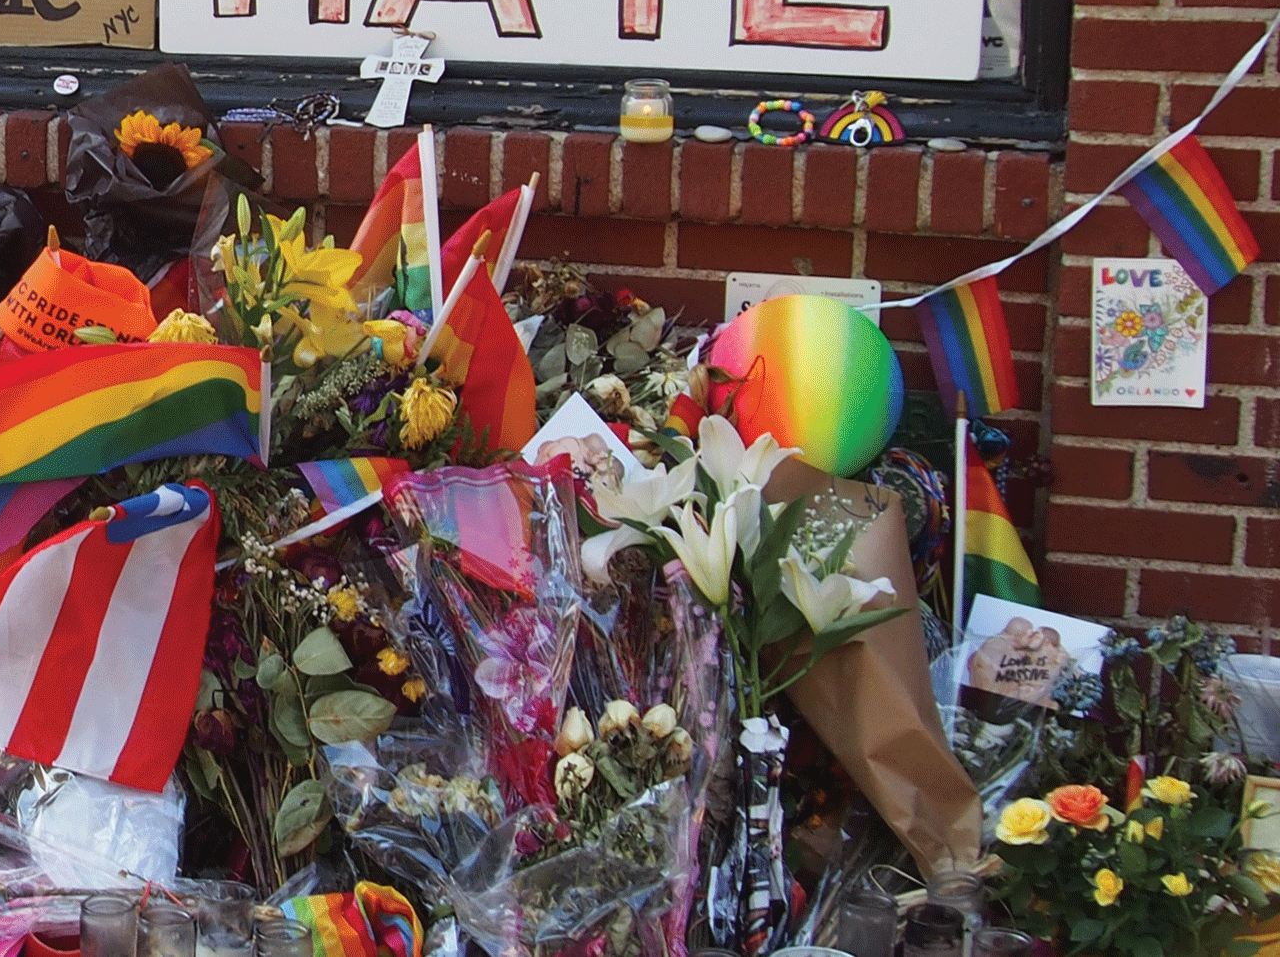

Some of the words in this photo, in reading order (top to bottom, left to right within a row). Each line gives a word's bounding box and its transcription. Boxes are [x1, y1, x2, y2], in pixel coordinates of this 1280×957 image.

[102, 5, 140, 44] NYC
[1101, 267, 1164, 288] LOVE
[26, 289, 81, 328] PRIDE
[1116, 386, 1180, 396] ORLANDO
